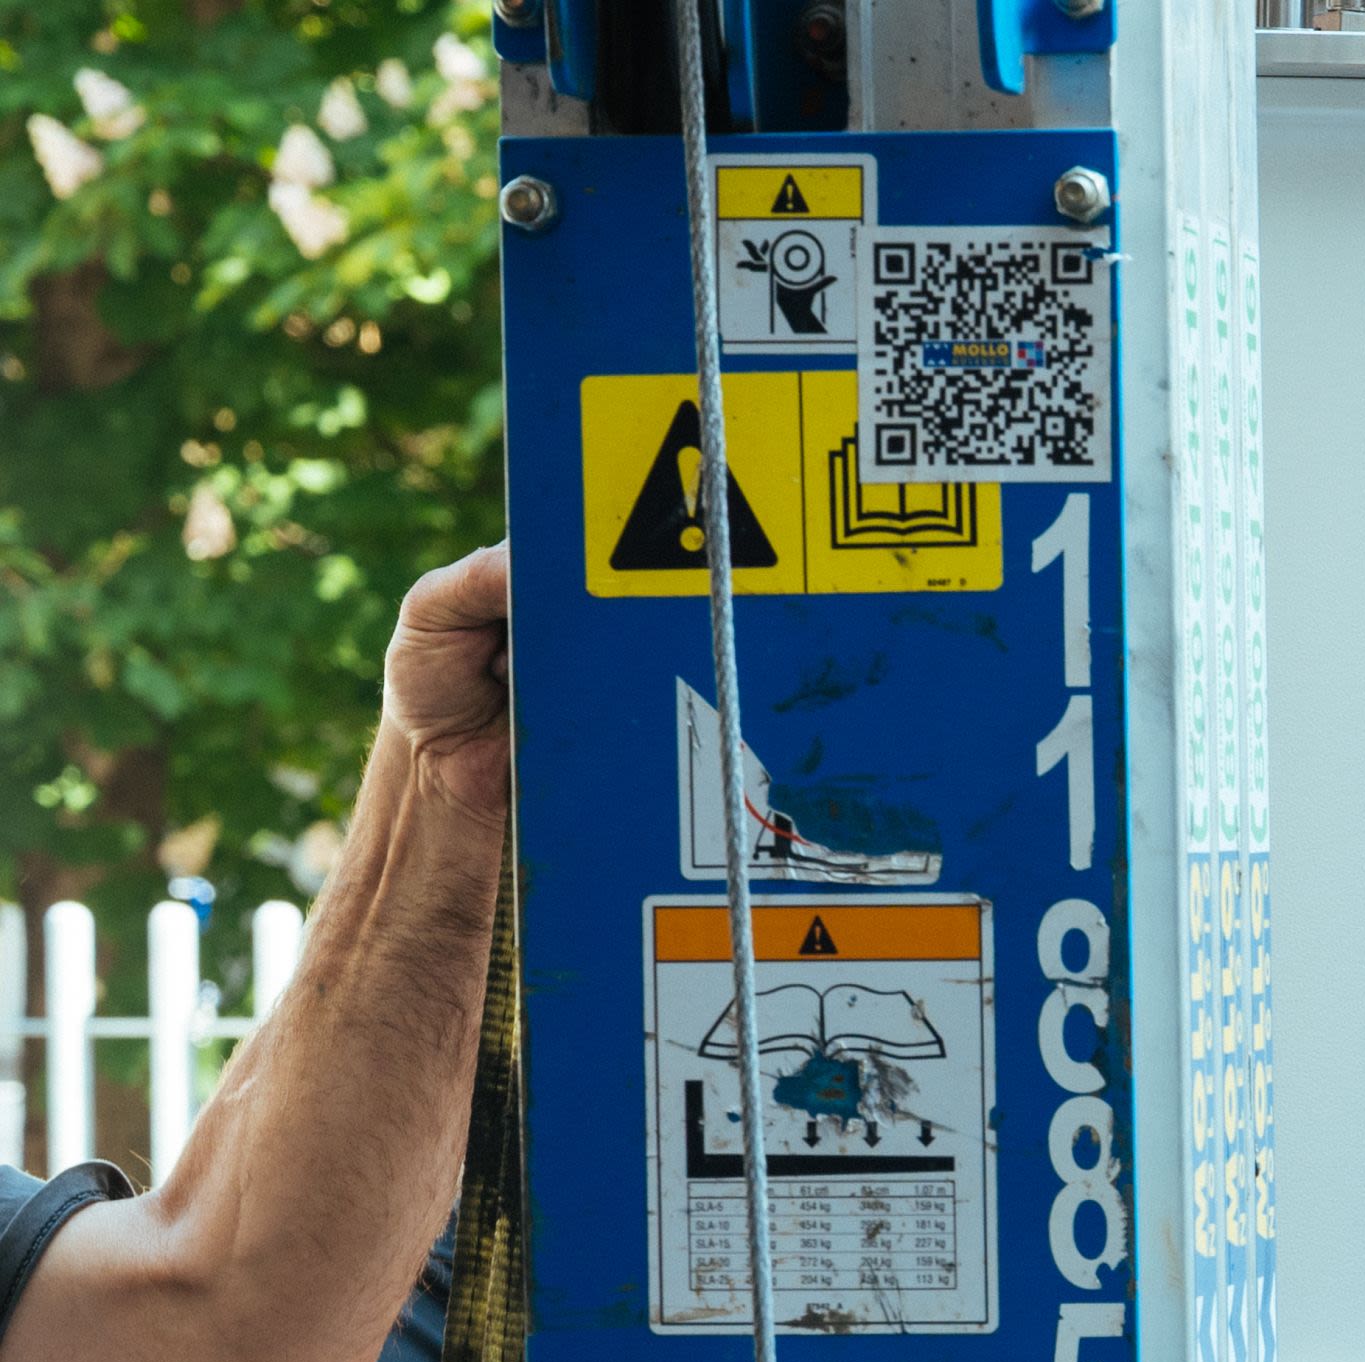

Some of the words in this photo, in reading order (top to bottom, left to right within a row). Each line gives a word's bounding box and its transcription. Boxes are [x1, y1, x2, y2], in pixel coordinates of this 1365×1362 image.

[1185, 248, 1198, 345] 16
[1216, 260, 1228, 351] 16
[1245, 274, 1257, 364] 16
[952, 343, 1009, 356] MOLLO
[1187, 365, 1200, 480] 46
[1218, 374, 1230, 486] 46
[1247, 385, 1259, 495] 46
[1189, 503, 1201, 602] 61
[1220, 511, 1232, 605] 61
[1249, 518, 1262, 612] 61
[1191, 621, 1206, 790] 800
[1222, 624, 1236, 790] 800
[1252, 631, 1265, 792] 800
[1189, 863, 1209, 1257] MOLLO
[1220, 859, 1243, 1245] MOLLO
[1251, 861, 1272, 1241] MOLLO
[695, 1220, 731, 1231] SLA-10
[915, 1219, 932, 1229] 181
[800, 1200, 817, 1211] 454
[800, 1238, 817, 1249] 363
[914, 1238, 932, 1248] 227
[800, 1256, 817, 1267] 272
[800, 1274, 818, 1285] 204
[916, 1274, 933, 1284] 113
